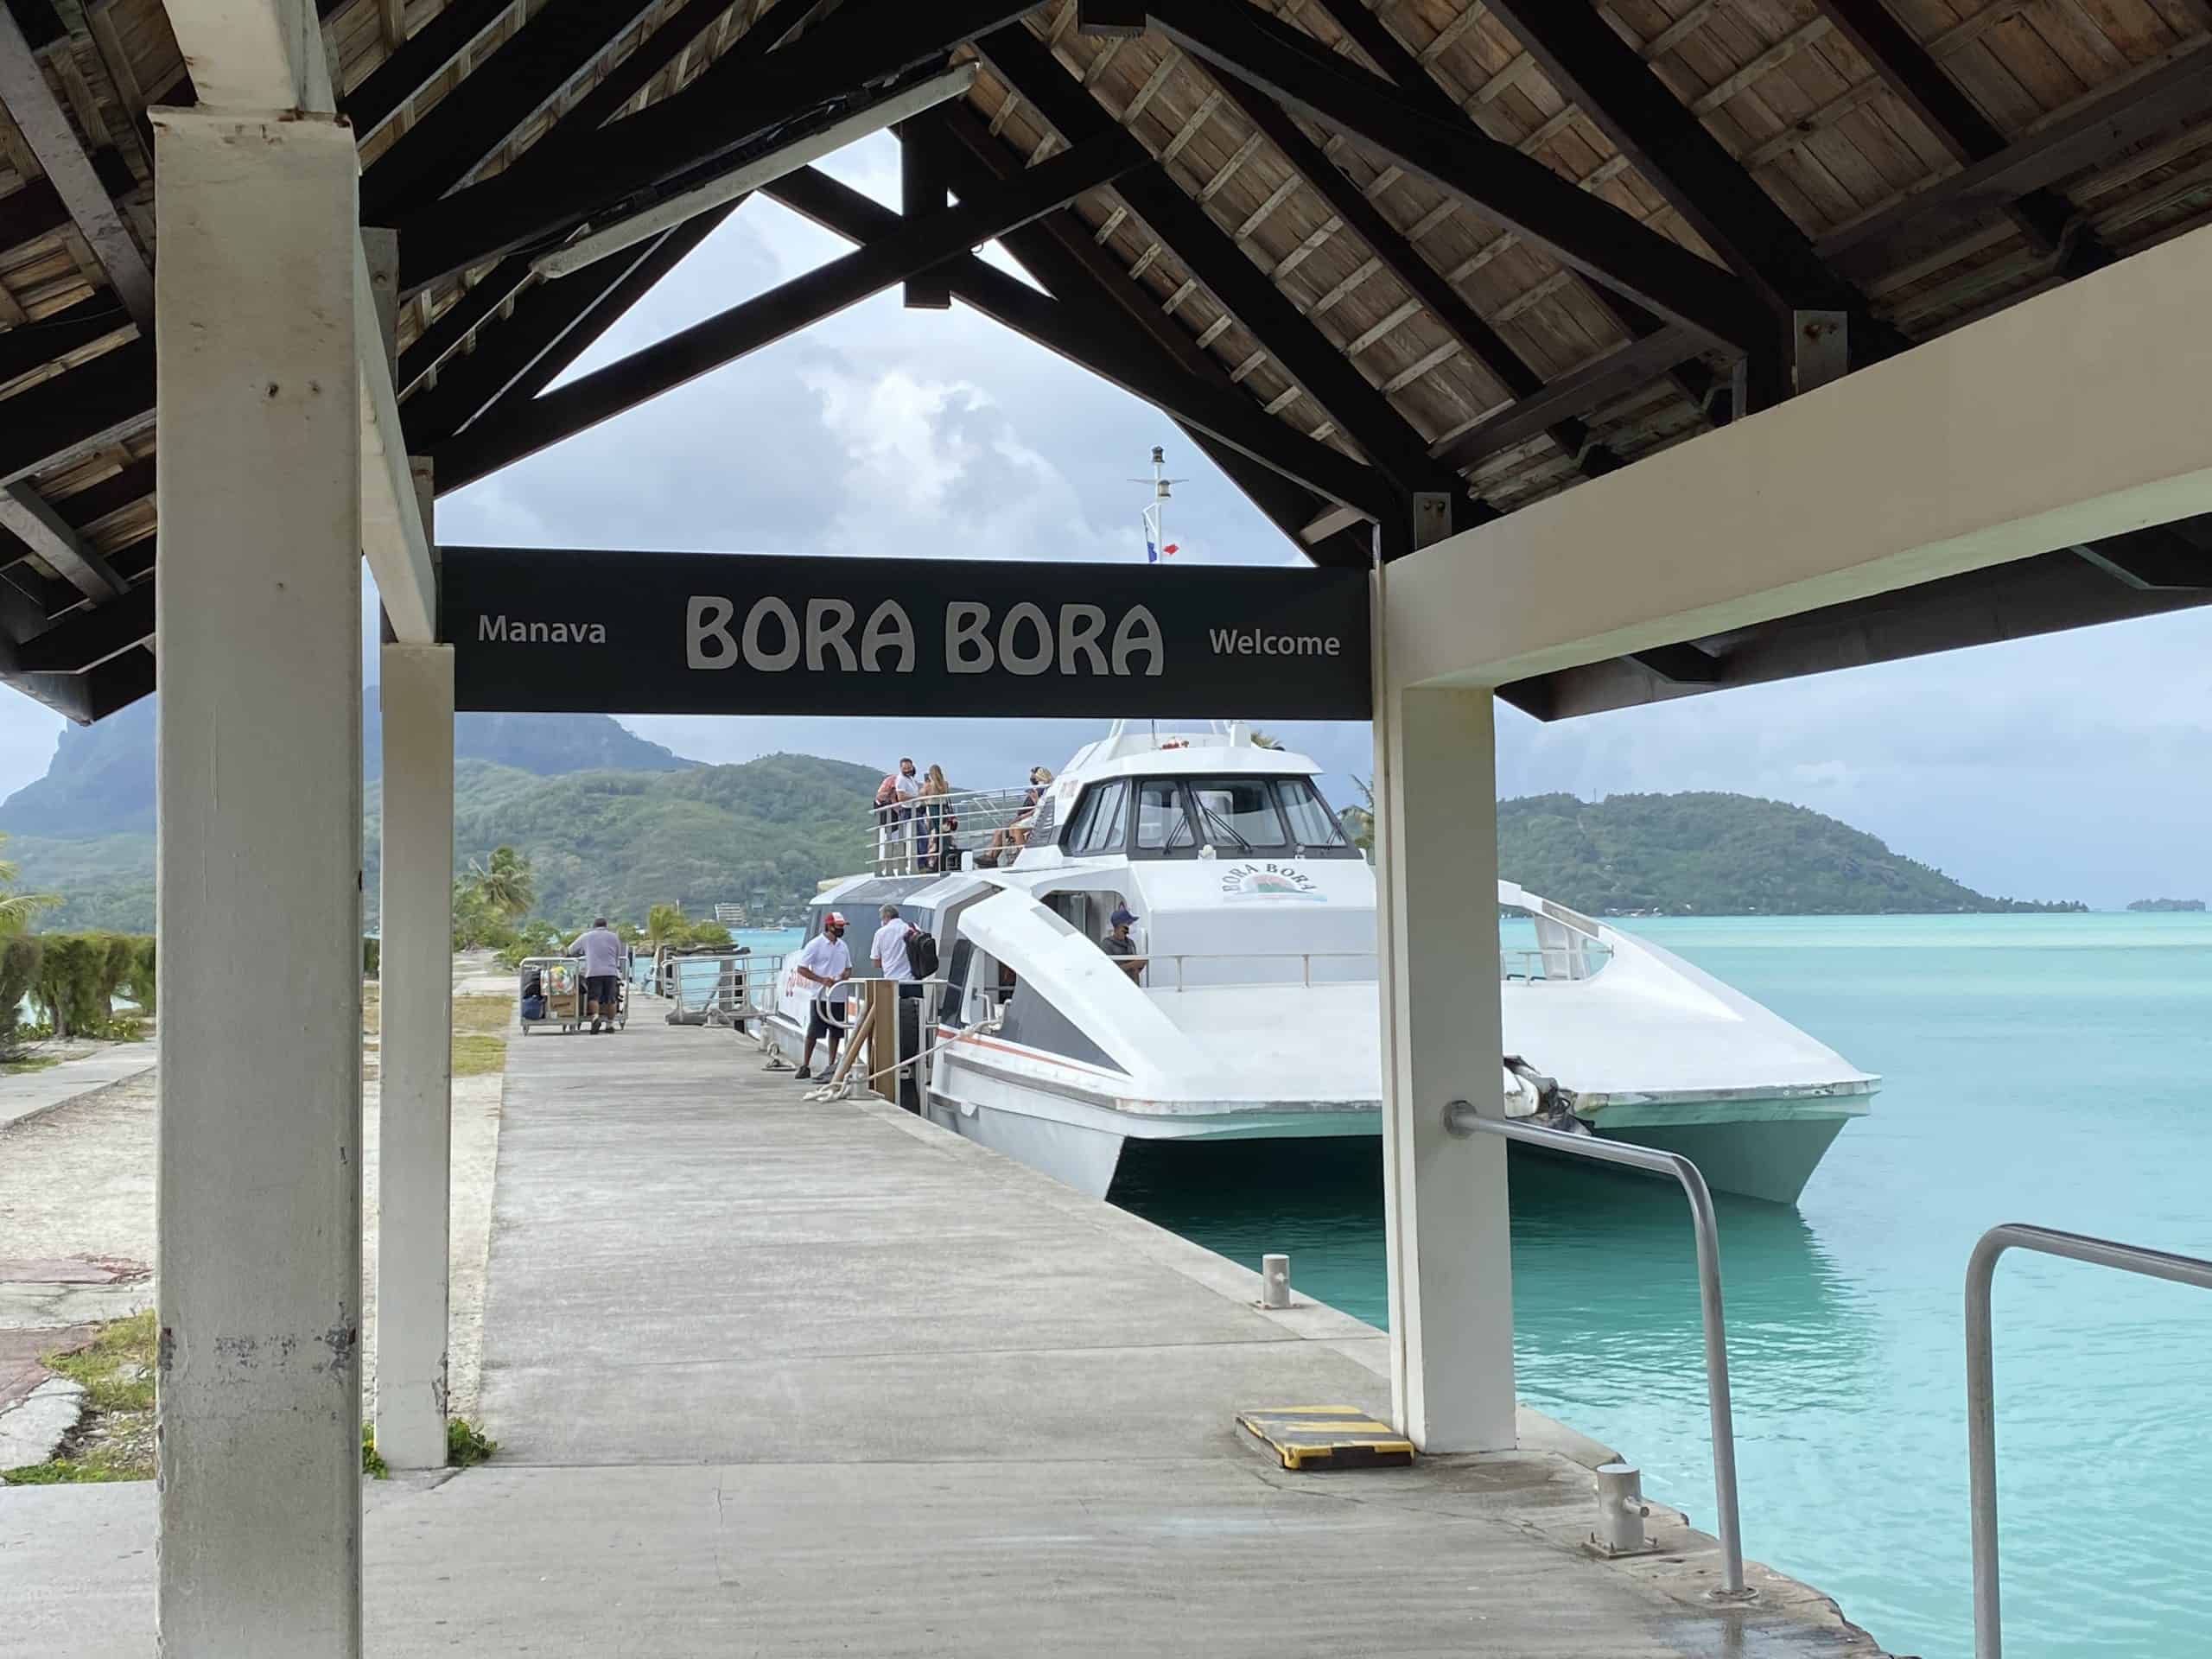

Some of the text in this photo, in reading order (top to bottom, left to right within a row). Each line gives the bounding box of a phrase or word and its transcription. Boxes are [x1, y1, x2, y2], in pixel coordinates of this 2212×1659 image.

[478, 595, 1341, 676] Manava BORA BORA Welcome
[1222, 863, 1317, 892] BORA BORA
